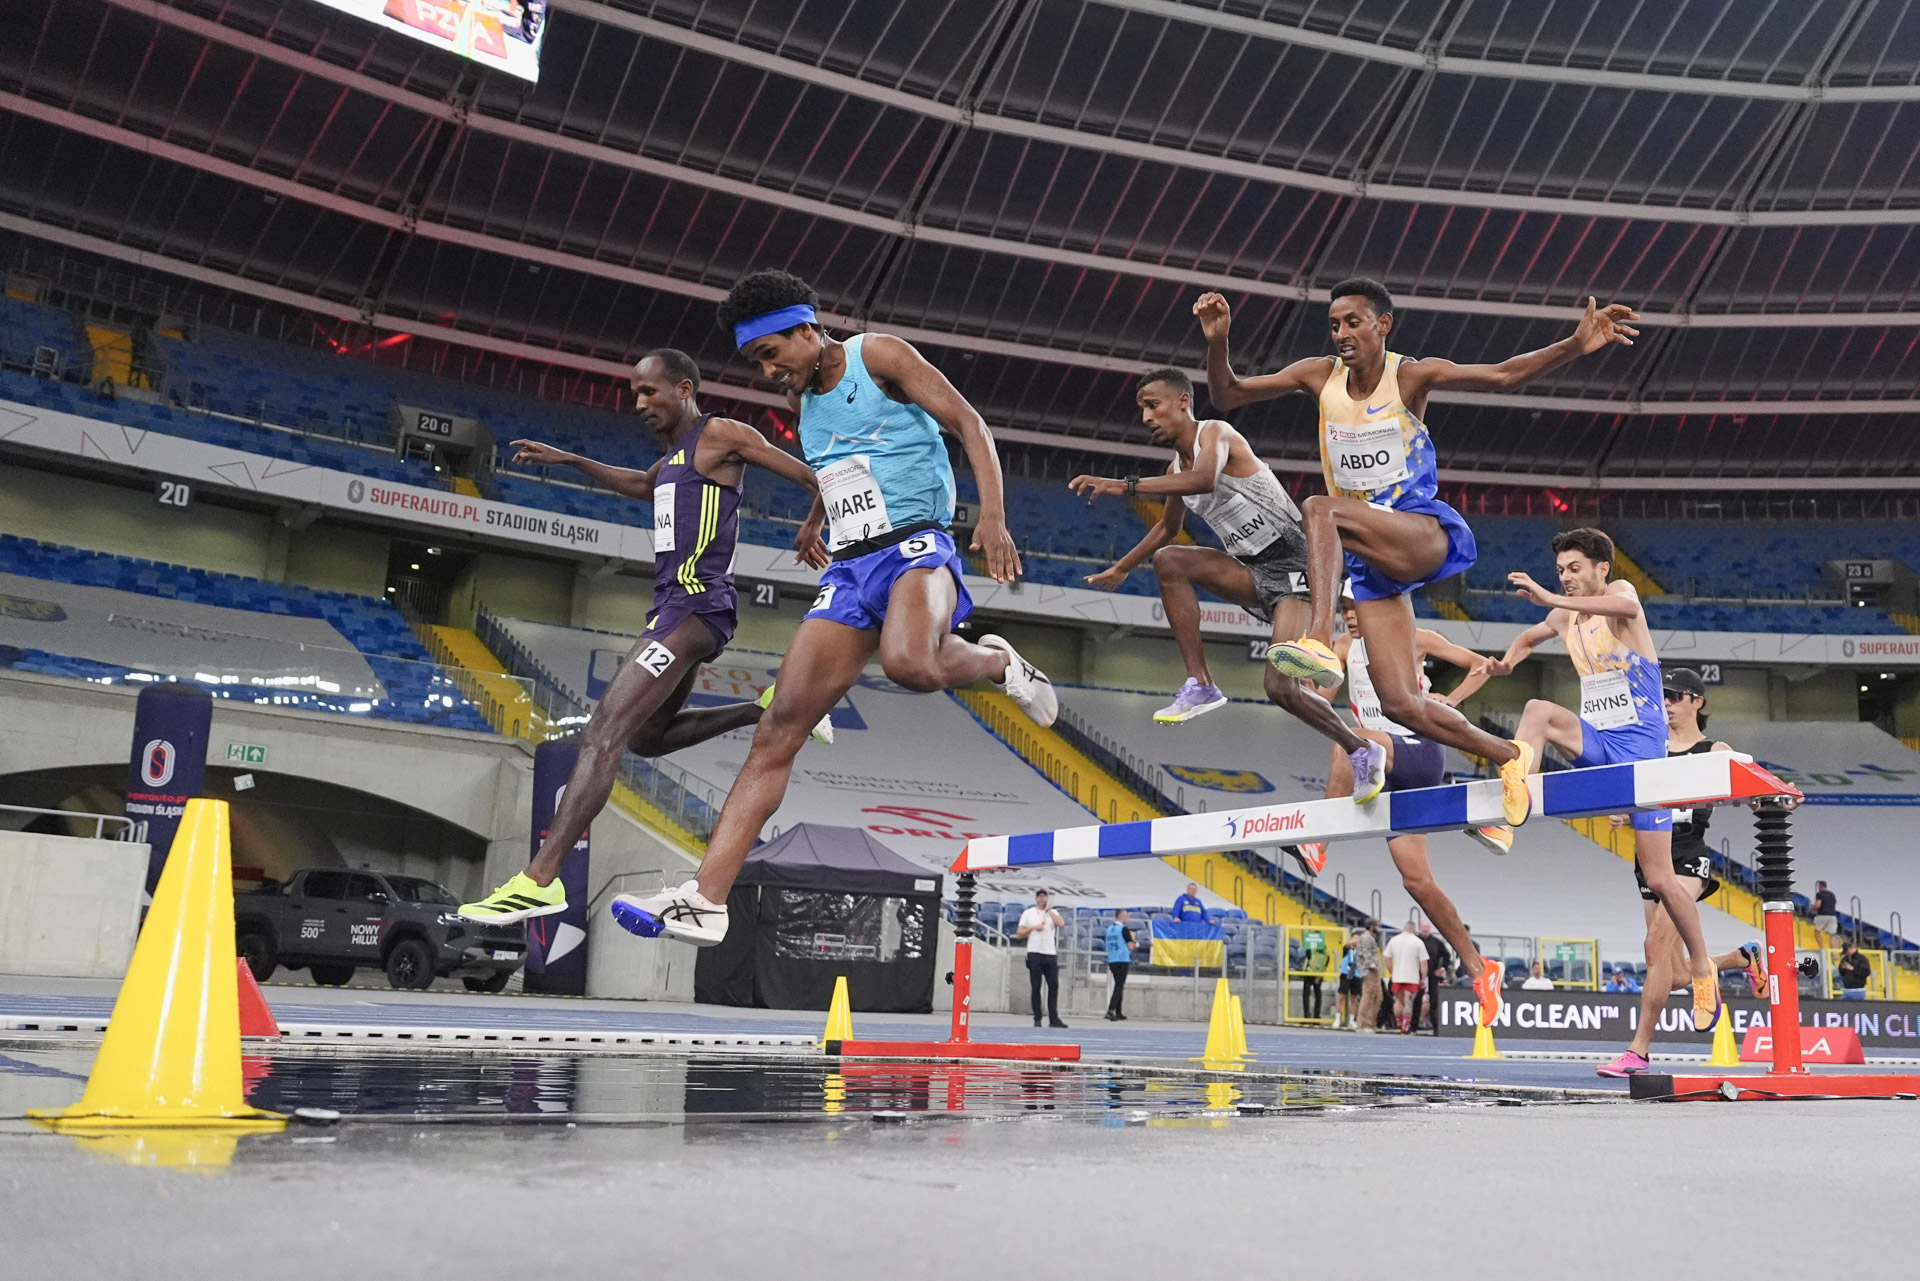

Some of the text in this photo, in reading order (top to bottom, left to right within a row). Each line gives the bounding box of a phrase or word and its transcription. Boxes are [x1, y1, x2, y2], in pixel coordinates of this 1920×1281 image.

[415, 1, 494, 46] PZA
[420, 416, 438, 431] 20
[1340, 450, 1390, 469] ABDO
[159, 481, 190, 506] 20
[370, 487, 599, 545] SUPERAUTO.PL STADION ŚLĄSKI
[1223, 514, 1265, 549] AYALEW
[1848, 566, 1862, 576] 23
[756, 584, 774, 604] 21
[1200, 611, 1252, 626] RAUTO.PL
[643, 647, 670, 673] 12
[1701, 664, 1720, 682] 23
[1584, 693, 1629, 714] SCHYNS
[867, 825, 1004, 840] ORLE
[1242, 809, 1306, 839] polanik
[301, 926, 319, 938] 500
[350, 924, 380, 935] NOWY
[351, 934, 379, 945] HILUX
[1441, 1000, 1449, 1026] I
[1629, 1005, 1637, 1031] I
[1653, 1007, 1695, 1032] UN
[1885, 1014, 1920, 1038] CL
[1754, 1037, 1832, 1055] PA
